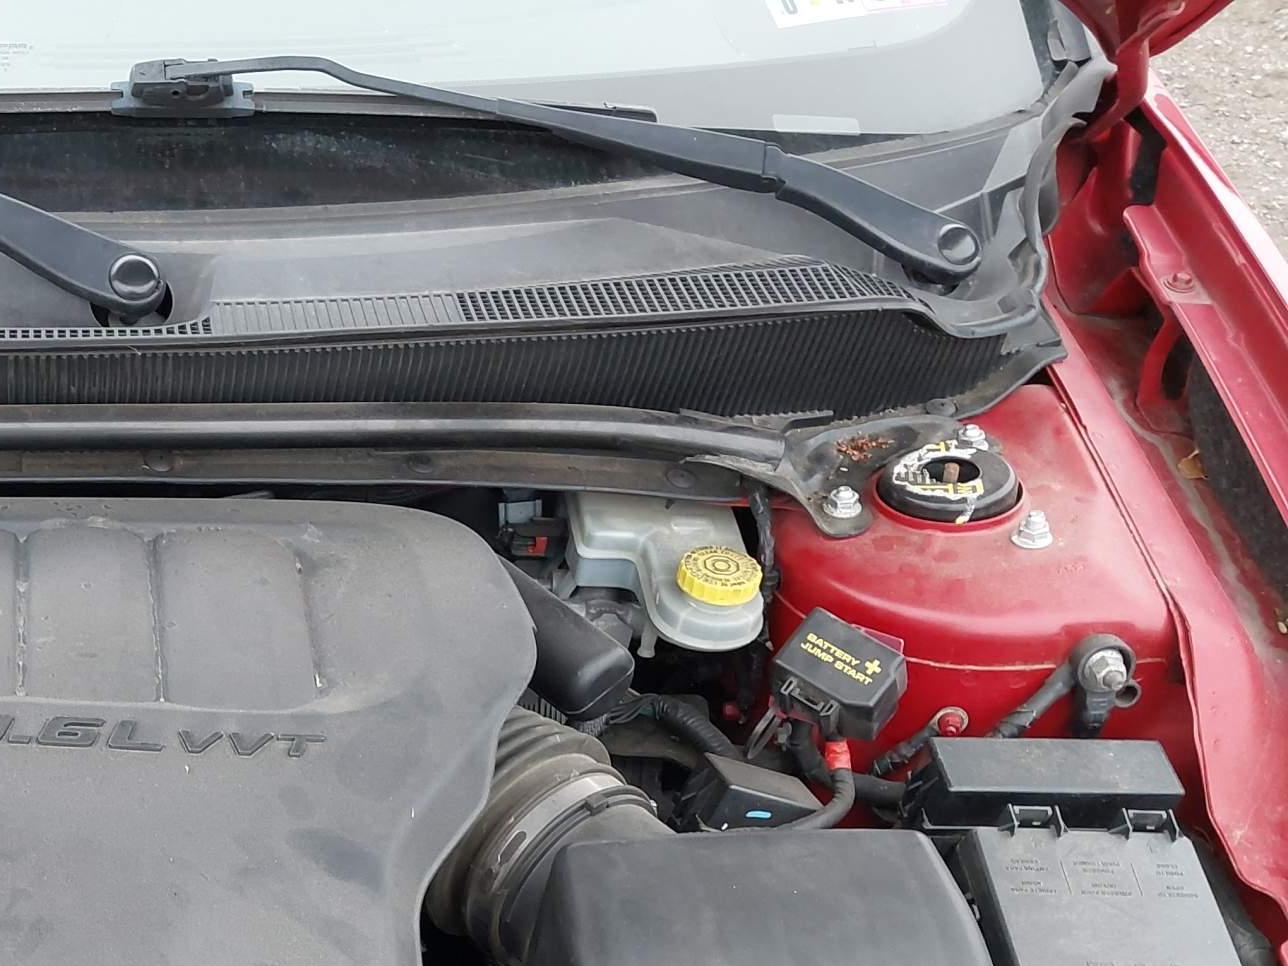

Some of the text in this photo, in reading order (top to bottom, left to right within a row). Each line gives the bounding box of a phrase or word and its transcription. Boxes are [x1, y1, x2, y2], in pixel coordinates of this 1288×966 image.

[800, 642, 873, 685] JUMP START
[806, 632, 860, 666] BATTERY
[177, 729, 327, 758] VVT
